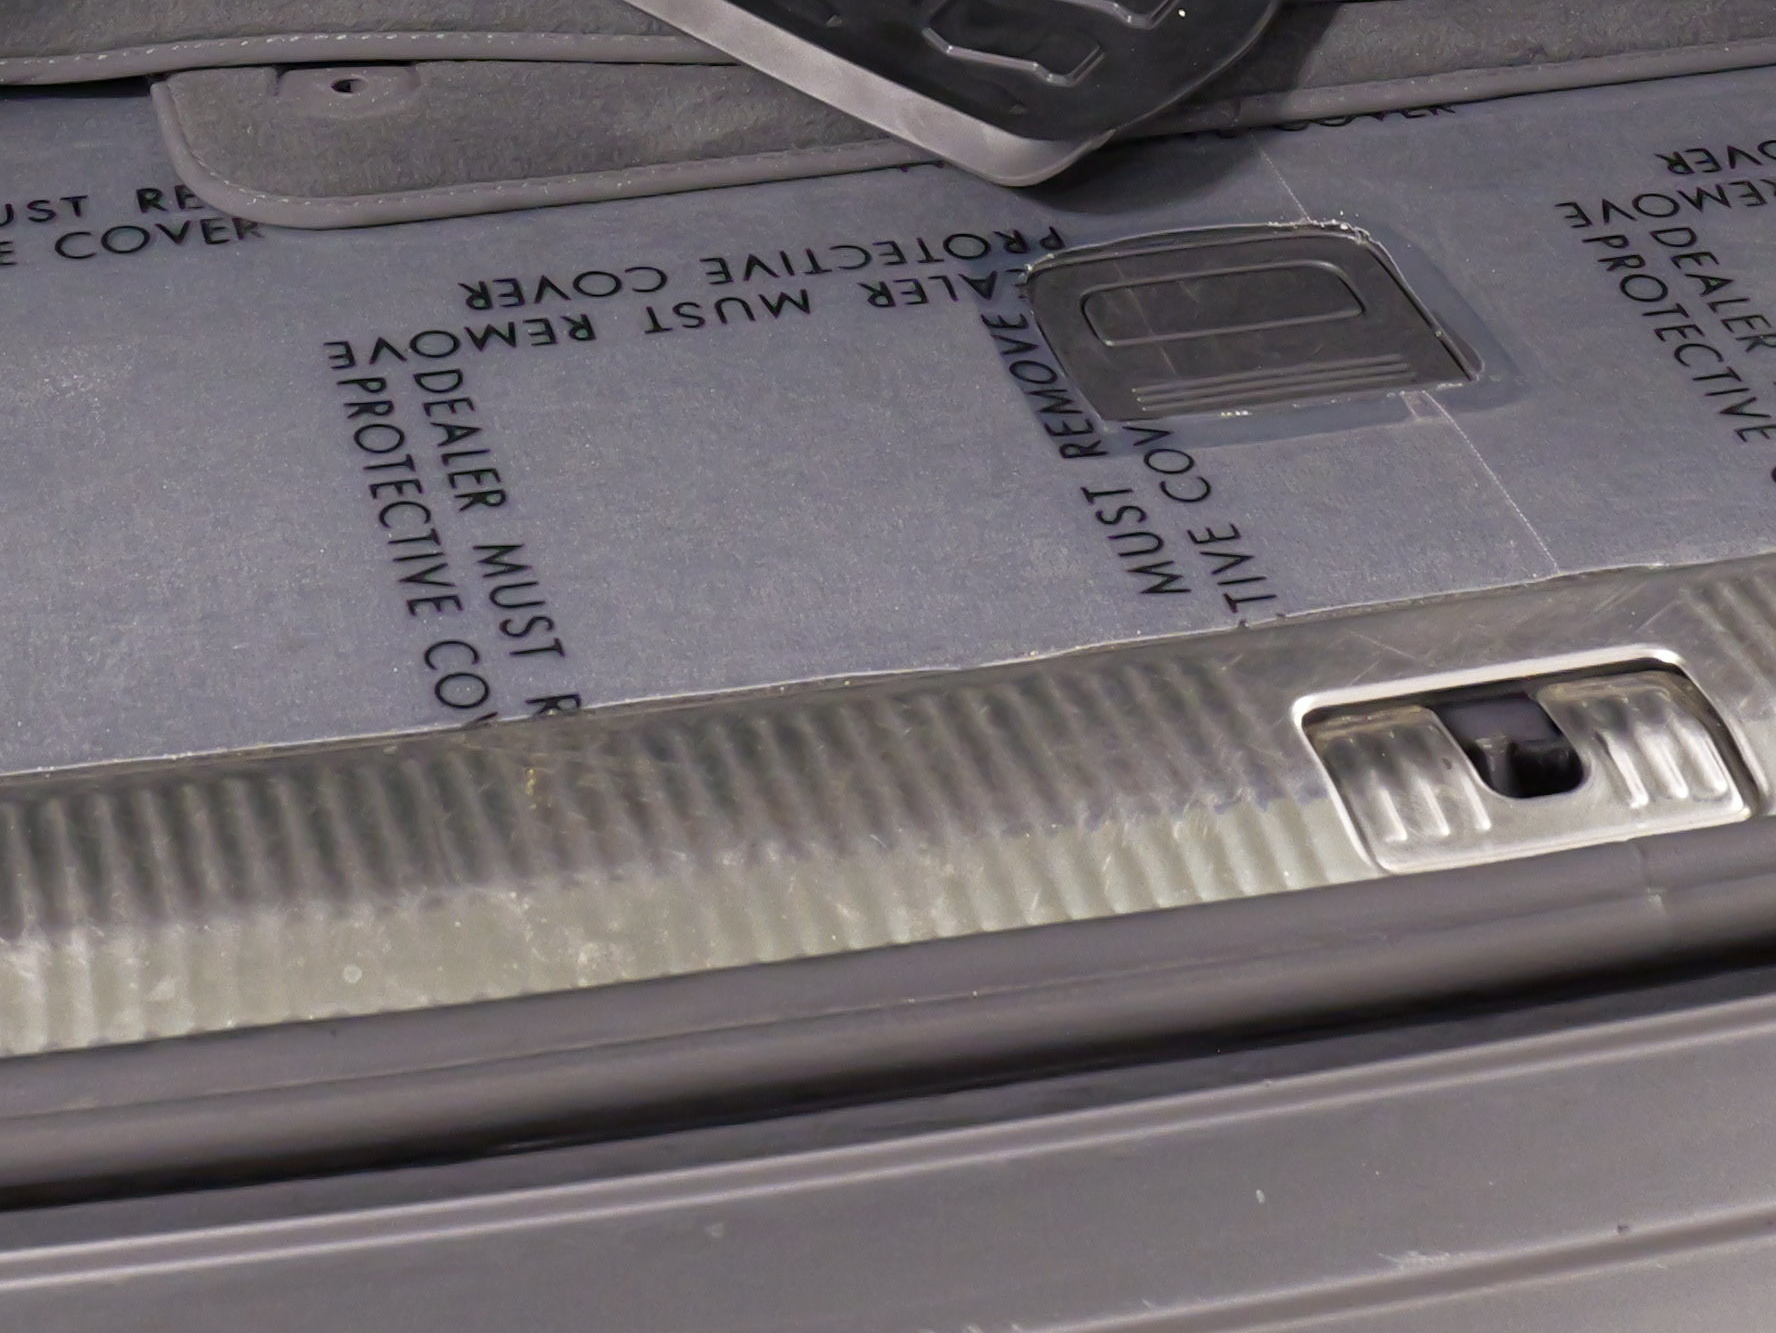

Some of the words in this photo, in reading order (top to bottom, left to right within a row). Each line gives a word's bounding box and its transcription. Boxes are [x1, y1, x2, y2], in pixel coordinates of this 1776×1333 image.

[54, 217, 264, 260] COVER
[702, 225, 1065, 285] PROTECTIVE
[461, 265, 668, 312] COVER
[643, 288, 812, 335] MUST
[324, 313, 596, 371] REMOVE
[981, 313, 1110, 459] REMOVE
[413, 369, 506, 513] DEALER
[473, 542, 565, 662] MUST
[1082, 487, 1191, 595] MUST
[338, 377, 463, 616] PROTECTIVE
[424, 640, 498, 727] CO
